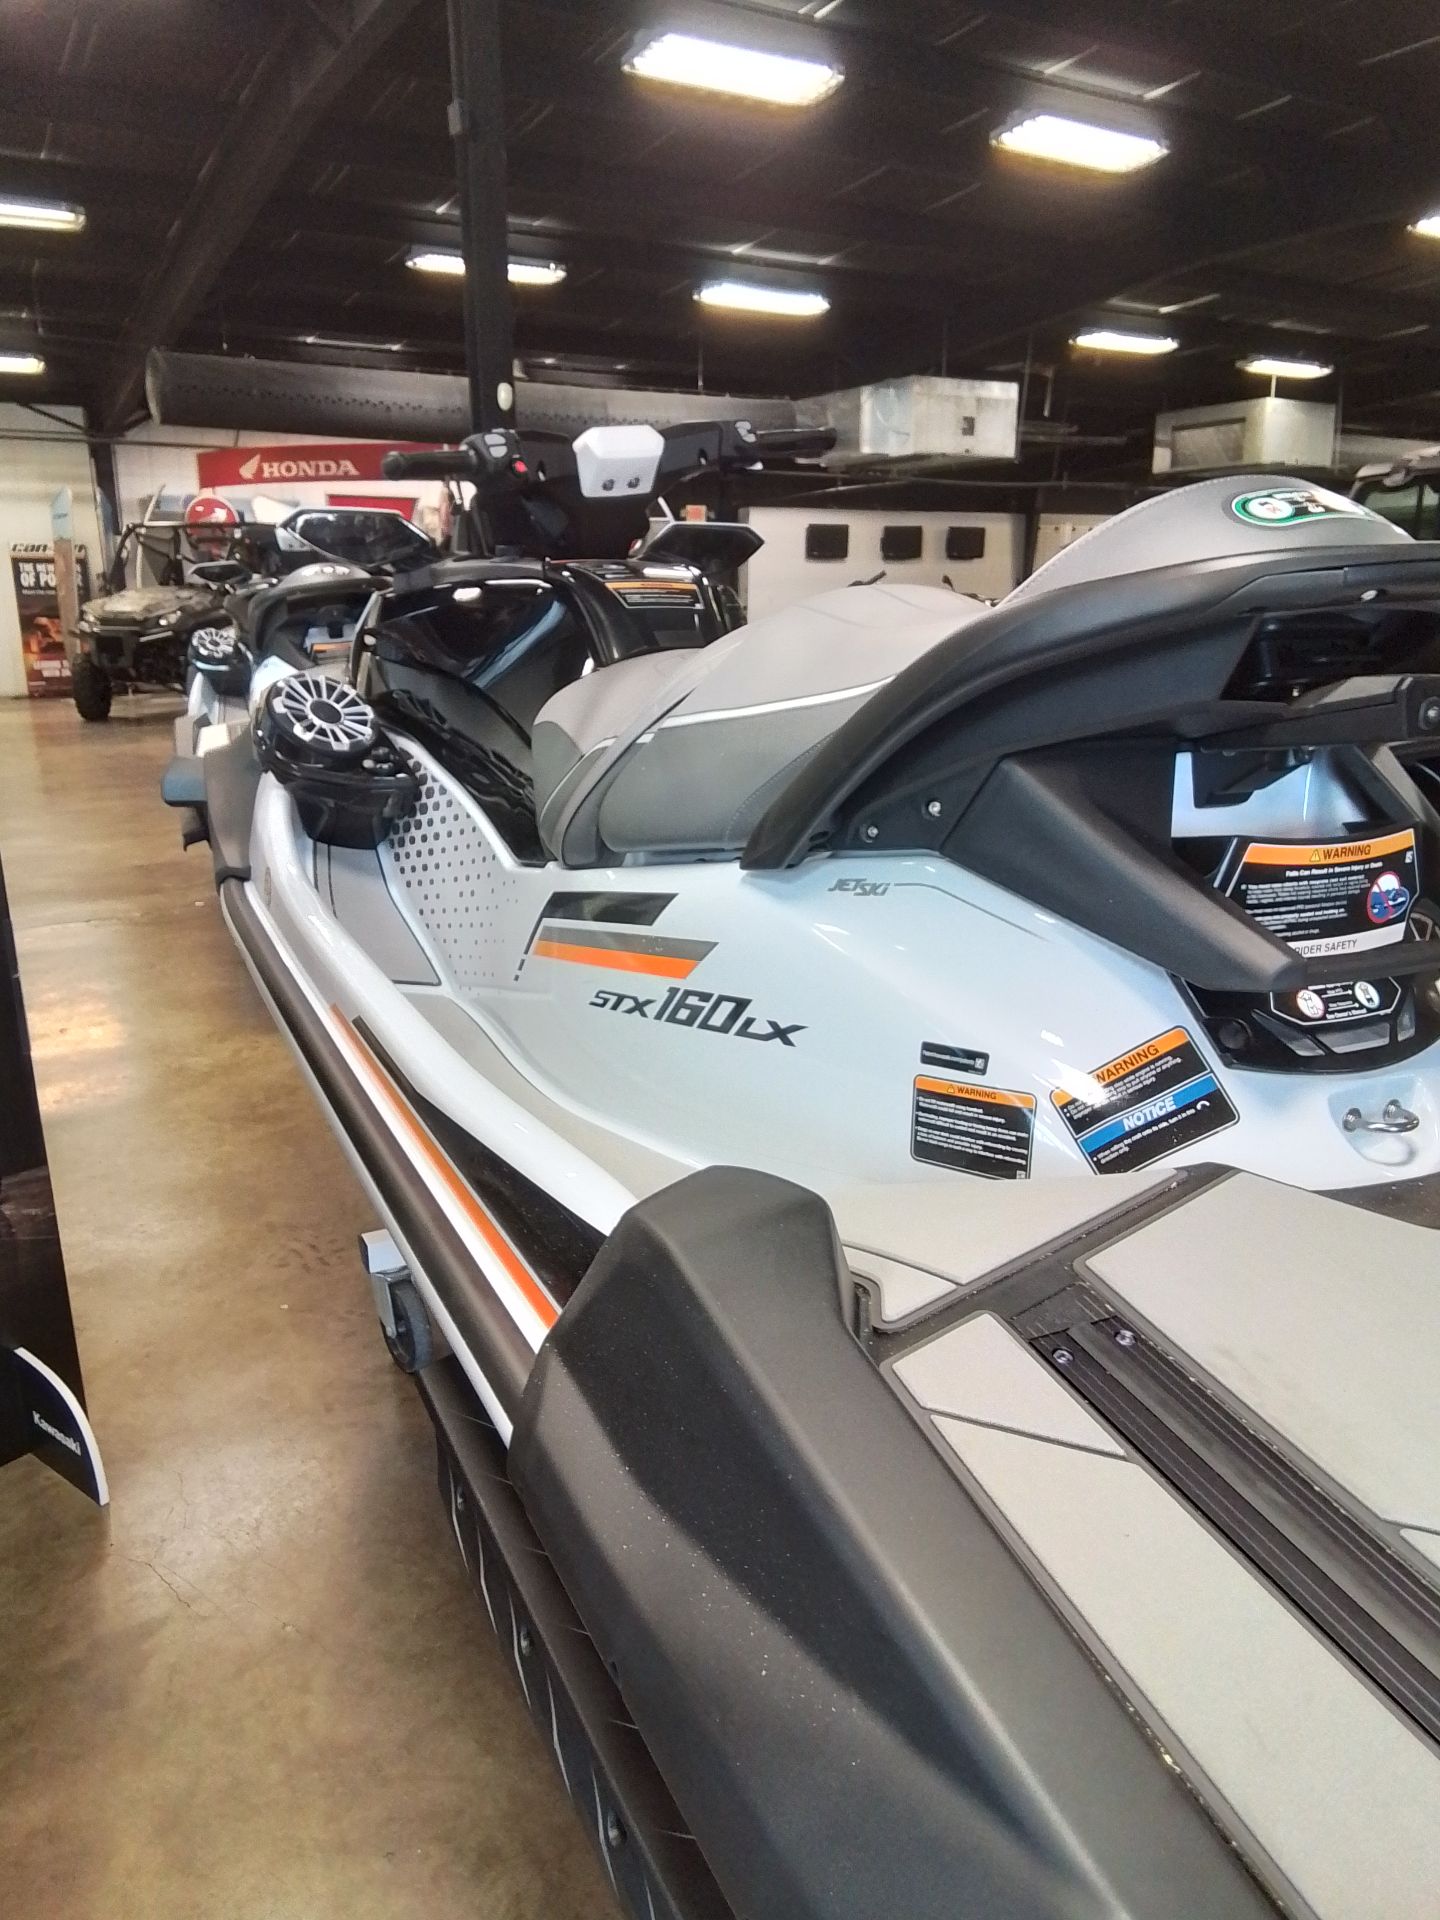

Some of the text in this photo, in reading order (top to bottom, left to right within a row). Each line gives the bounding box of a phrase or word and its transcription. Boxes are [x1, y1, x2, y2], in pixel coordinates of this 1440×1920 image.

[262, 459, 360, 478] HONDA
[19, 562, 35, 573] THE
[20, 573, 36, 587] OF
[1323, 844, 1371, 861] WARNING
[1325, 939, 1358, 953] SAFETY
[956, 1086, 997, 1100] WARNING
[1122, 1096, 1177, 1132] NOTICE
[32, 1410, 82, 1457] Kawasaki
